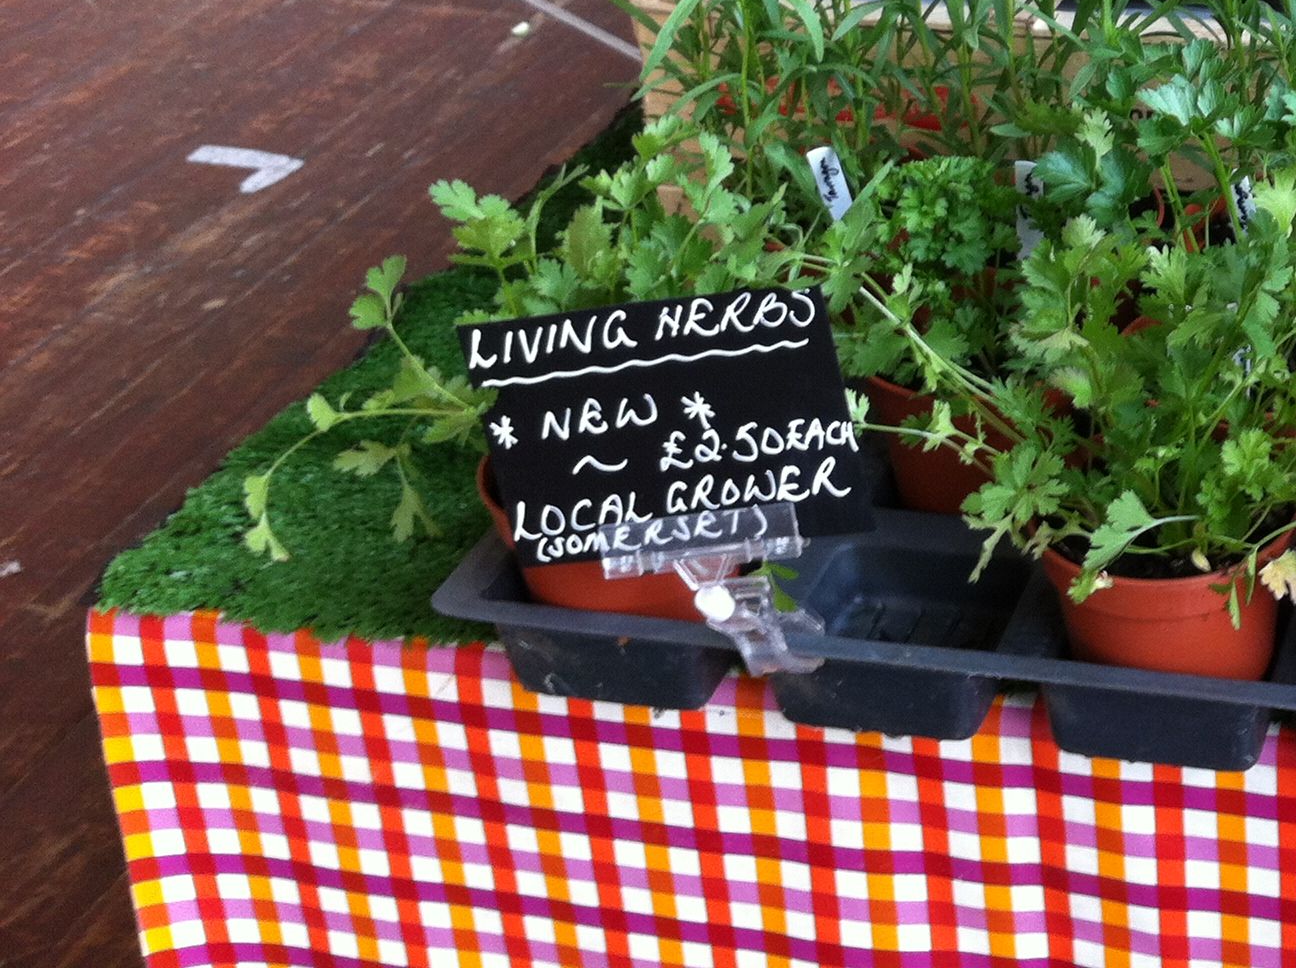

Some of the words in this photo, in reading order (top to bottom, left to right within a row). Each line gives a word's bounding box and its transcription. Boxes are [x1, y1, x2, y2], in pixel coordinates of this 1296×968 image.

[469, 309, 638, 370] LIVING
[654, 289, 816, 341] HERBS
[541, 393, 658, 441] NEW
[512, 491, 652, 542] LOCAL
[666, 457, 852, 514] GROWER
